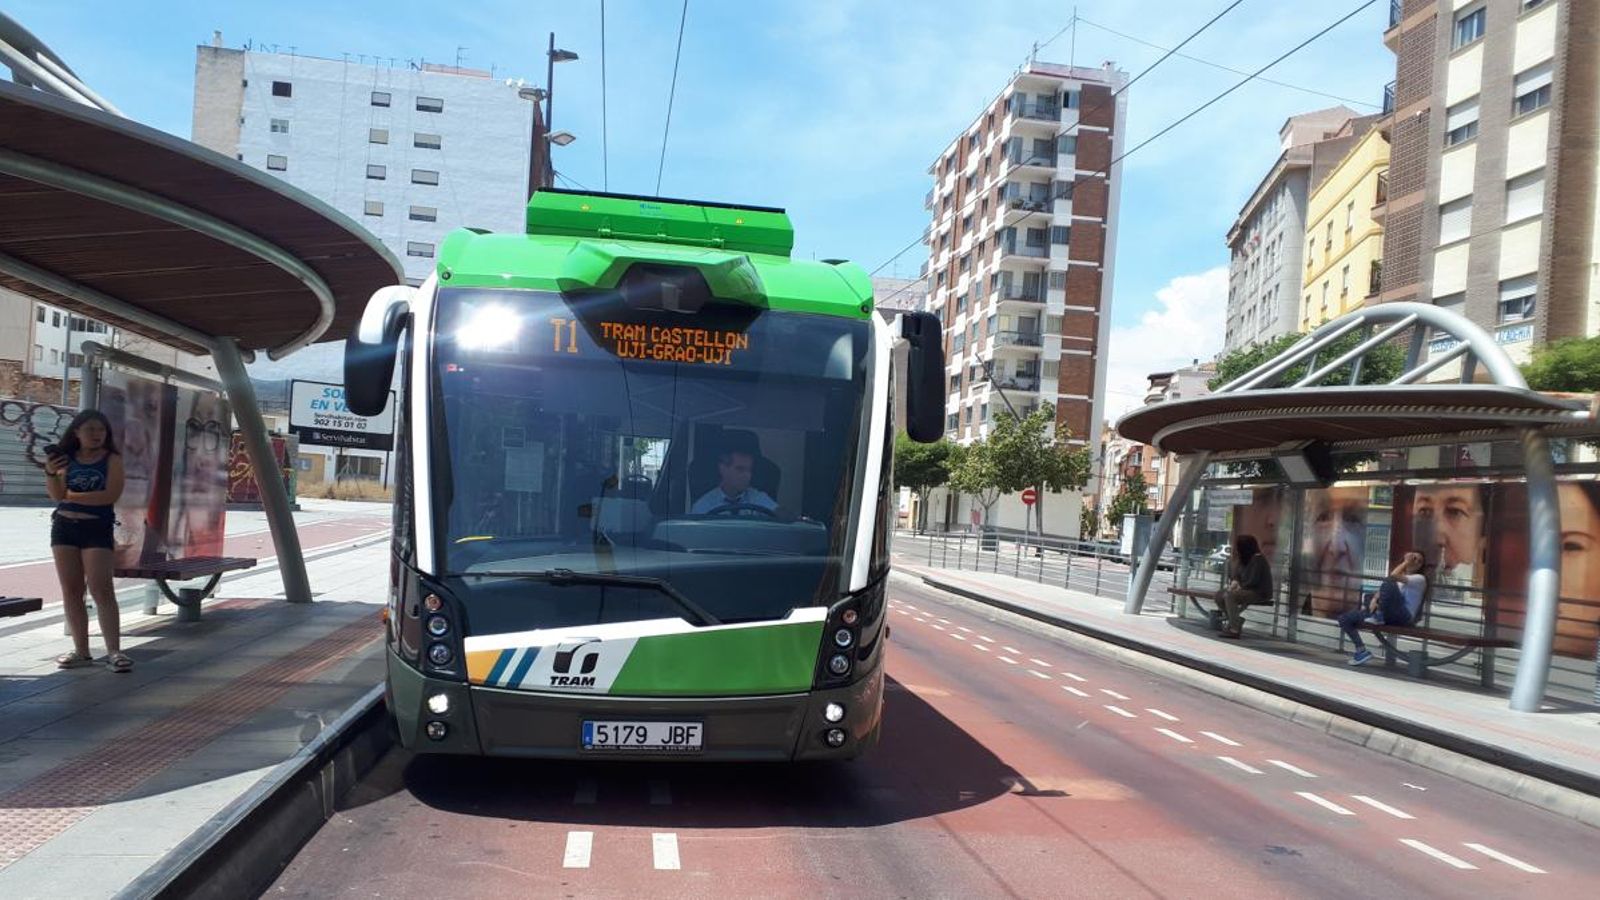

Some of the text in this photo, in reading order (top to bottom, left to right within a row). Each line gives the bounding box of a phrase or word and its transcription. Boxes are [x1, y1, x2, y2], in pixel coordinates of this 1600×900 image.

[550, 318, 578, 353] T1
[601, 322, 749, 349] TRAM CASTELLON
[617, 341, 732, 365] UJI-GRAO-UJI
[310, 400, 329, 410] EN
[550, 676, 596, 686] TRAM
[597, 725, 698, 744] 5179 JBF
